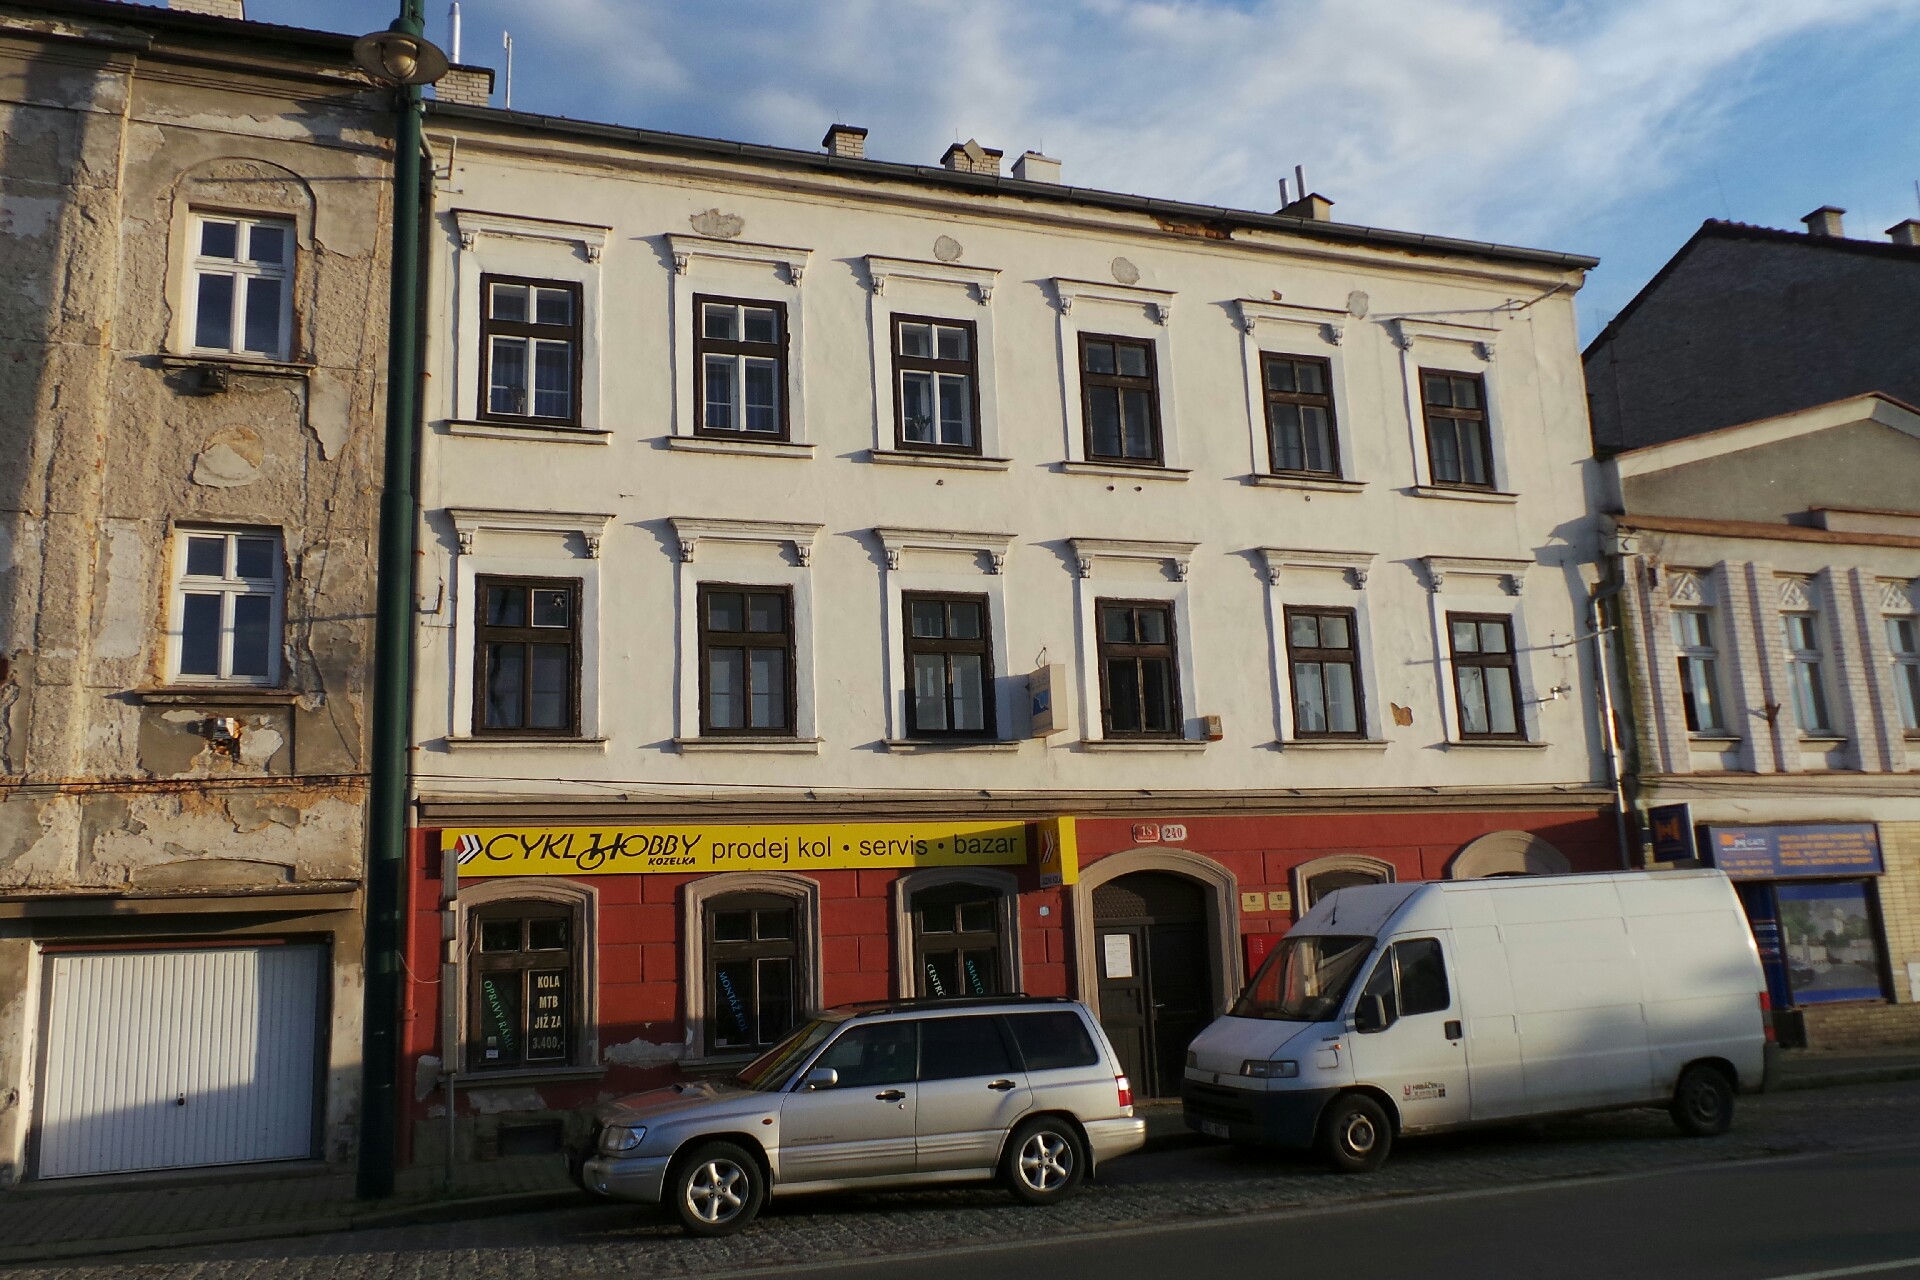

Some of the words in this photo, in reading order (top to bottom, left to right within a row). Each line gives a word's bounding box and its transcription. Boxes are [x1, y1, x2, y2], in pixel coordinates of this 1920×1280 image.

[1142, 825, 1153, 836] 18
[1165, 827, 1183, 839] 240
[712, 835, 789, 863] prodej
[798, 834, 831, 858] kol
[859, 834, 928, 856] servis
[954, 833, 1018, 854] bazar
[648, 856, 696, 866] KOZELKA
[537, 975, 560, 989] KOLA
[718, 969, 742, 1012] MONTÁŽ
[483, 980, 504, 1019] OPRAVY
[539, 995, 558, 1009] MTB
[534, 1013, 549, 1029] JIŽ
[551, 1017, 562, 1029] ZA
[532, 1036, 564, 1050] 3.400,-
